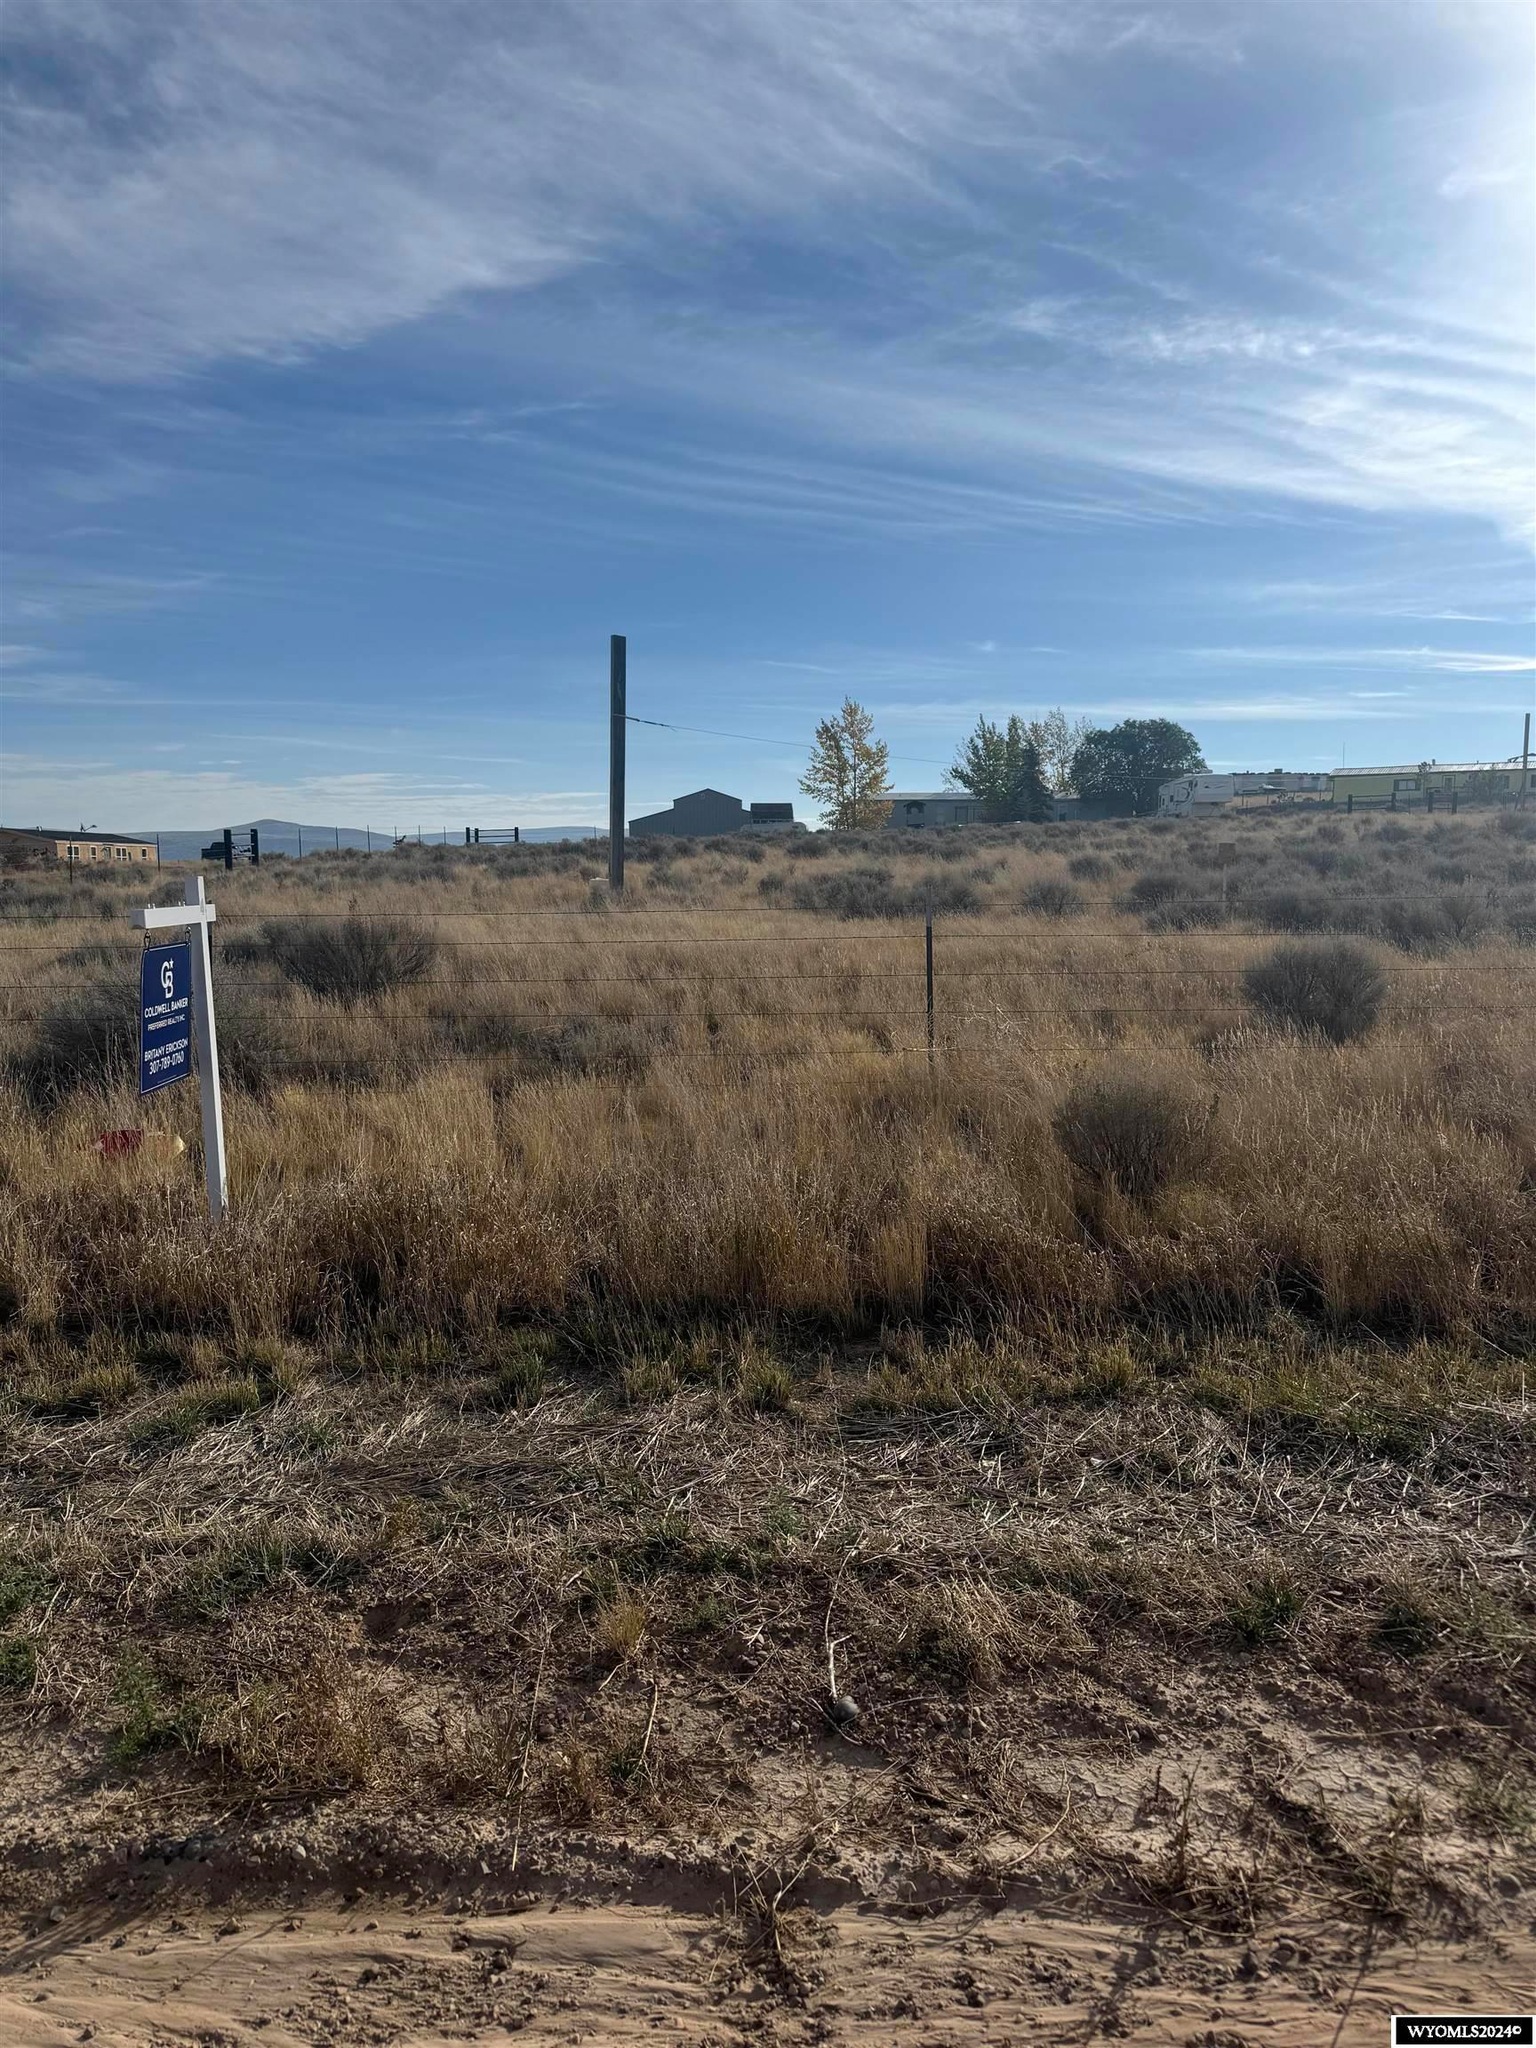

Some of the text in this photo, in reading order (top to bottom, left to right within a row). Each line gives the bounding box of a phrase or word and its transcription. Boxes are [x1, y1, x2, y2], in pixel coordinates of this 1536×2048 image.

[144, 997, 188, 1018] COLDWELL BANKER
[144, 1038, 188, 1061] BRITANY ERICKSON
[149, 1050, 184, 1074] 307-789-0760
